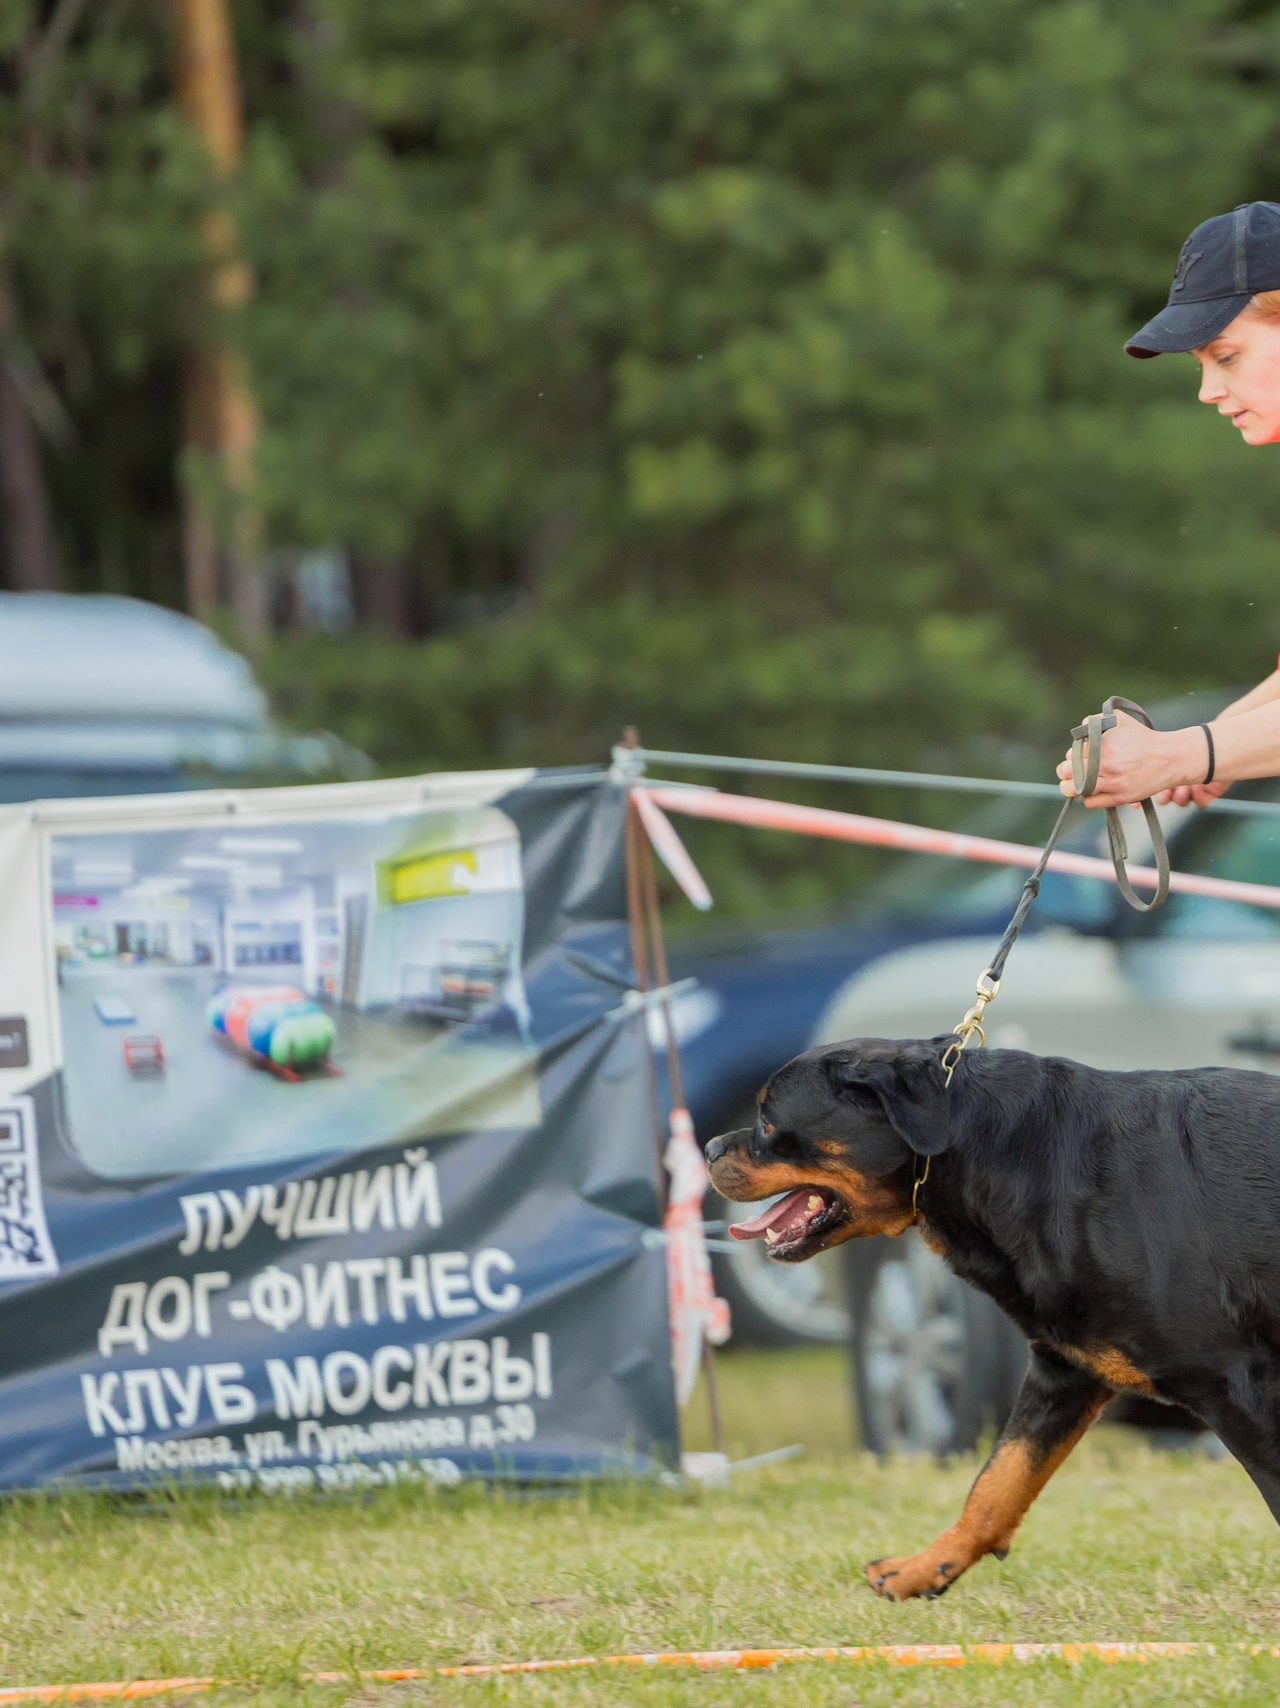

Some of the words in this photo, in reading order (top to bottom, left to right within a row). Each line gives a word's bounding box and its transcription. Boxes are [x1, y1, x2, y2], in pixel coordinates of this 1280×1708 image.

[178, 1148, 443, 1256] ЛУЧШИЙ
[98, 1248, 521, 1358] ДОГ-ФИТНЕС
[81, 1361, 257, 1438] КЛУБ
[264, 1332, 551, 1421] МОСКВЫ
[114, 1435, 239, 1473] Москва,
[244, 1430, 293, 1470] ул.
[297, 1419, 467, 1464] Гурьянова
